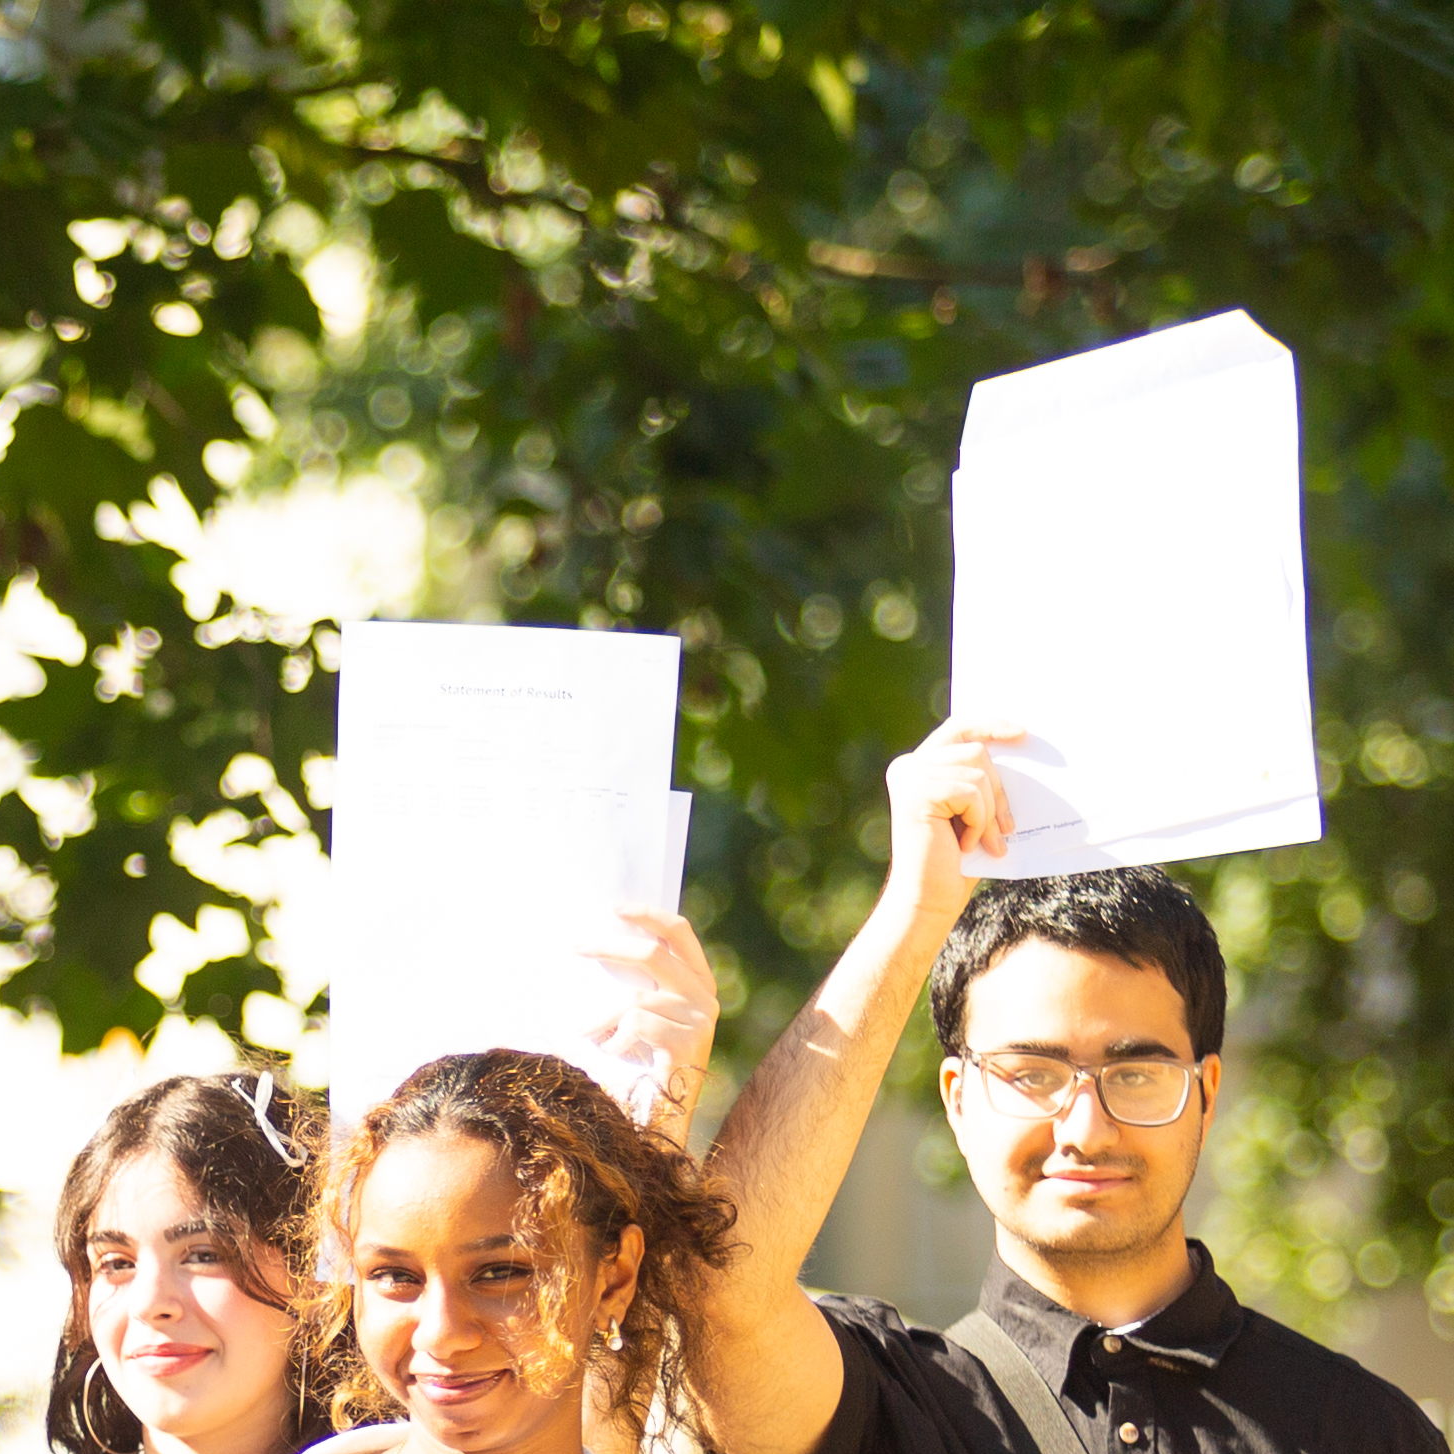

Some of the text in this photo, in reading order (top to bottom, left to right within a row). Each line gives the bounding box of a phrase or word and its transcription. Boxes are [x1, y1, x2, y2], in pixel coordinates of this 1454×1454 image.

[440, 683, 573, 700] Statement of Results
